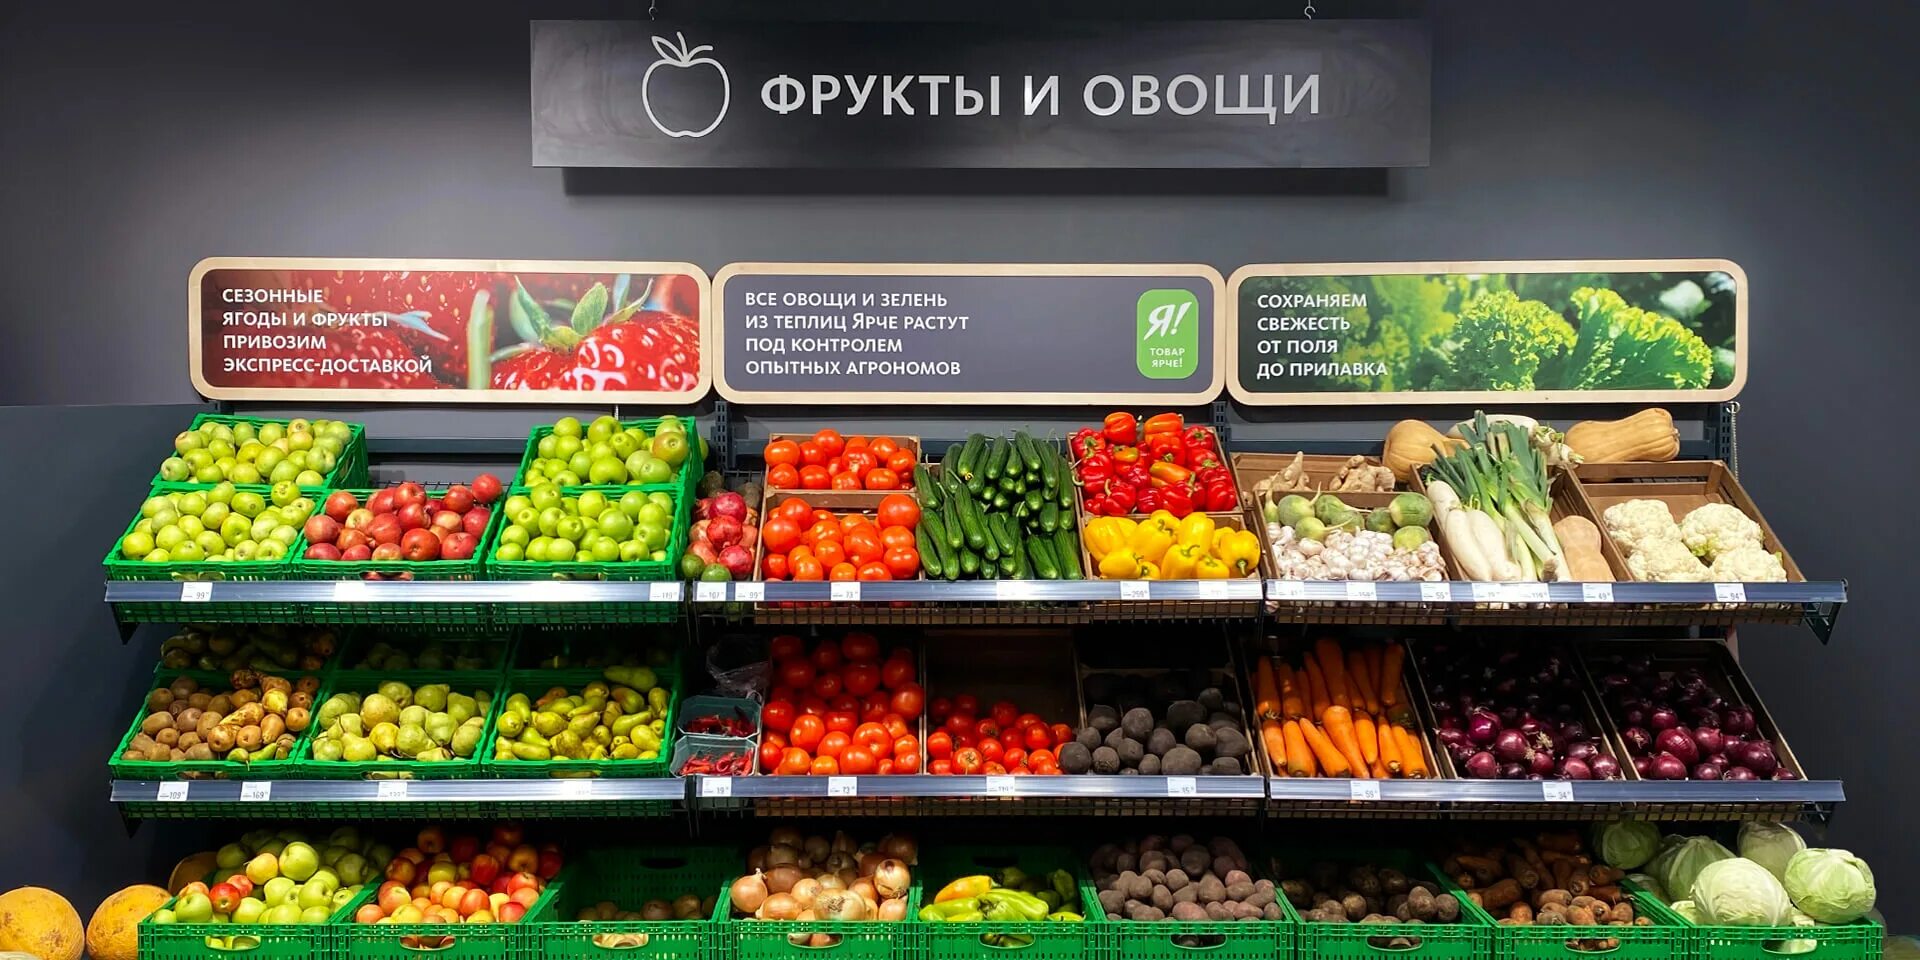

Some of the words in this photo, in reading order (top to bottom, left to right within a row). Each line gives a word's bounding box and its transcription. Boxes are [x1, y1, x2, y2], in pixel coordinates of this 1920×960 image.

[761, 74, 1000, 116] ФРУКТЫ
[1023, 75, 1059, 116] И
[1083, 74, 1320, 125] ОВОЩИ
[222, 288, 323, 303] СЕЗОННЫЕ
[745, 292, 777, 306] ВСЕ
[782, 292, 856, 310] ОВОЩИ
[862, 293, 875, 307] И
[880, 293, 948, 307] ЗЕЛЕНЬ
[1257, 293, 1367, 309] СОХРАНЯЕМ
[222, 311, 287, 329] ЯГОДЫ
[294, 312, 306, 326] И
[311, 311, 389, 328] ФРУКТЫ
[745, 315, 769, 329] ИЗ
[773, 315, 847, 332] ТЕПЛИЦ
[904, 316, 970, 330] РАСТУТ
[1141, 301, 1192, 341] Я!
[1257, 316, 1351, 331] СВЕЖЕСТЬ
[223, 335, 327, 350] ПРИВОЗИМ
[745, 337, 786, 354] ПОД
[791, 338, 903, 353] КОНТРОЛЕМ
[1257, 340, 1282, 354] ОТ
[1287, 339, 1338, 354] ПОЛЯ
[1149, 347, 1185, 356] ТОВАР
[223, 355, 433, 375] ЭКСПРЕСС-ДОСТАВКОЙ
[745, 360, 841, 375] ОПЫТНЫХ
[845, 361, 961, 375] АГРОНОМОВ
[1151, 358, 1184, 368] ЯРЧЕ!
[1256, 362, 1284, 380] ДО
[1289, 362, 1388, 377] ПРИЛАВКА
